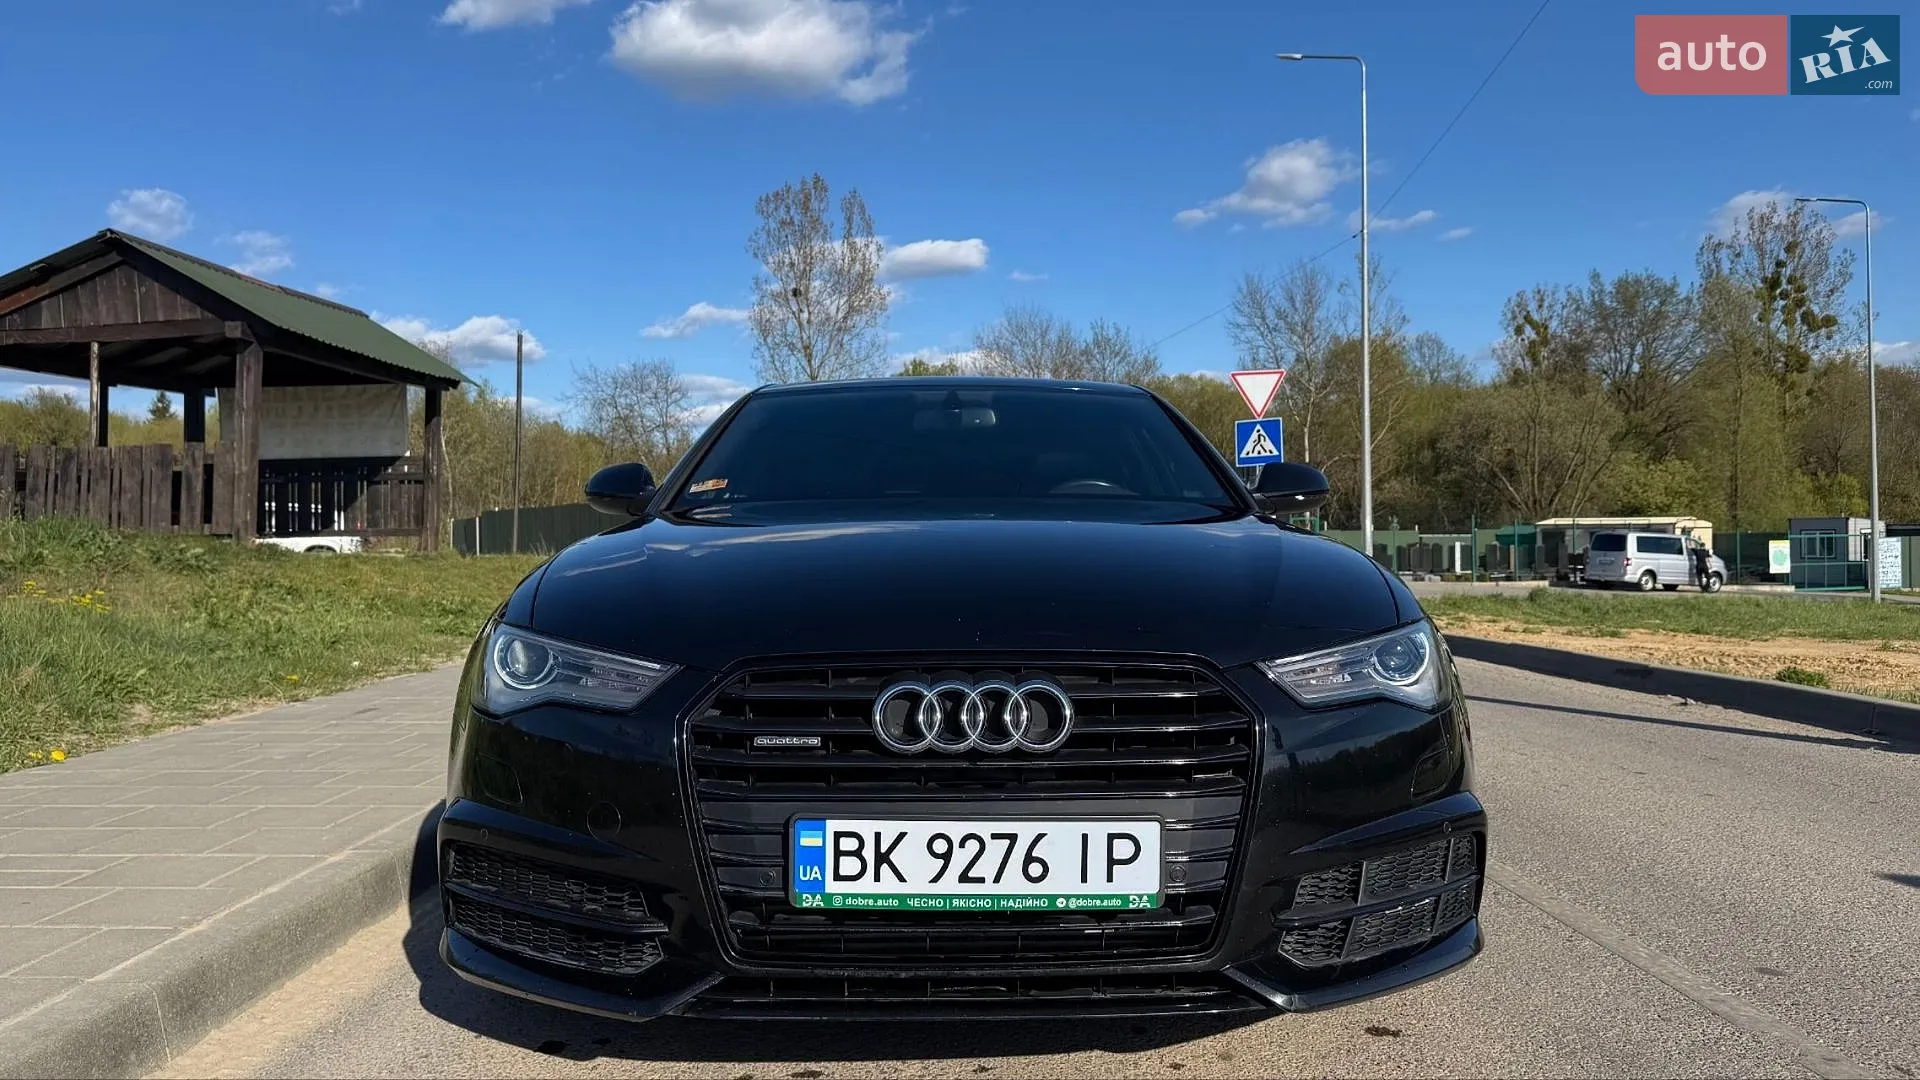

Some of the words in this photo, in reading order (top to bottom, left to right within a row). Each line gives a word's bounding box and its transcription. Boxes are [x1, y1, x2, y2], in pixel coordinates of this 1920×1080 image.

[757, 737, 818, 745] quattro
[832, 831, 908, 883] BK
[926, 832, 1050, 884] 9276
[1080, 832, 1142, 884] IP
[799, 865, 822, 881] UA
[845, 897, 899, 906] dobre.auto
[907, 898, 944, 907] ЧЕСНО
[952, 899, 992, 908] ЯКІСНО
[1000, 897, 1048, 909] НАДІЙНО
[1068, 898, 1121, 908] @dobre.auto
